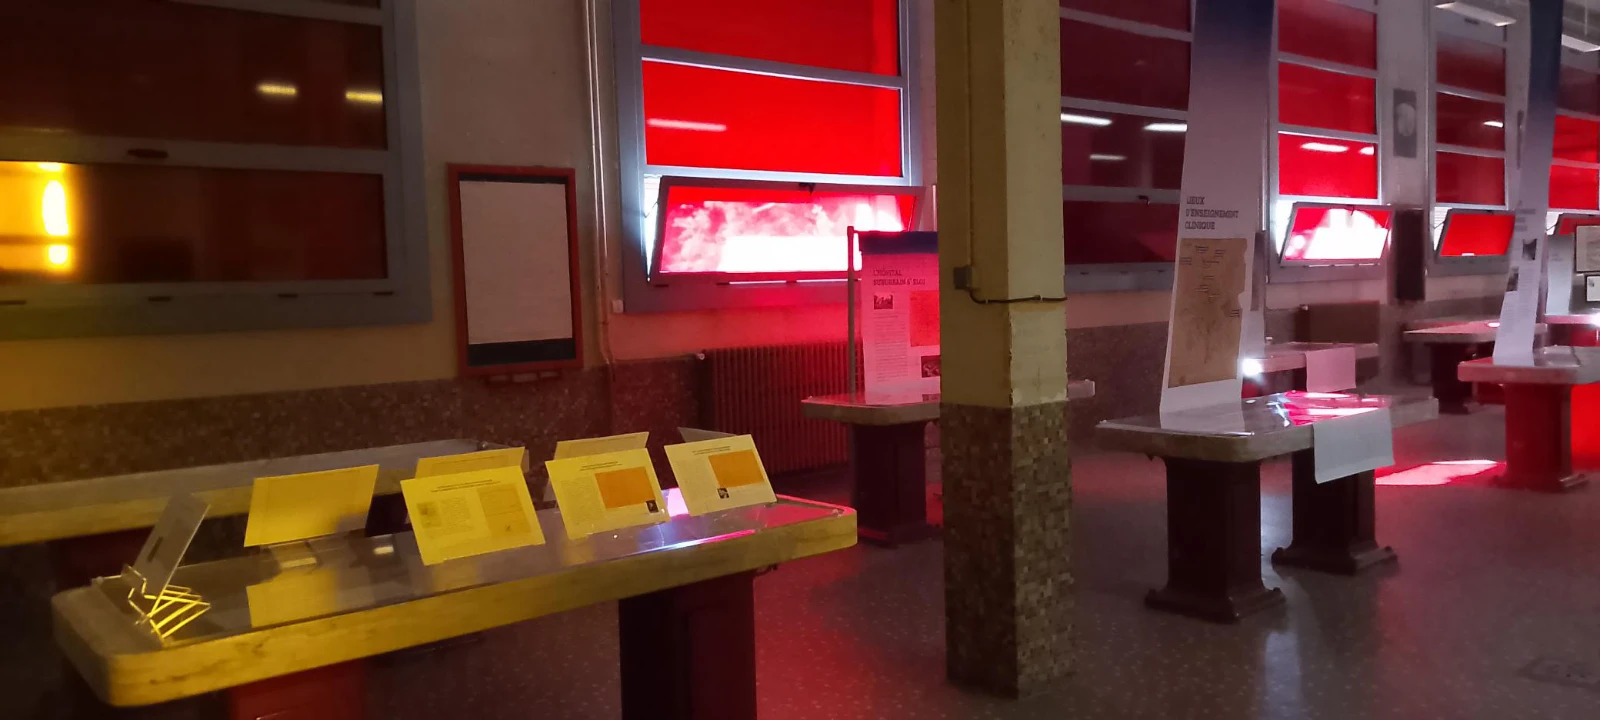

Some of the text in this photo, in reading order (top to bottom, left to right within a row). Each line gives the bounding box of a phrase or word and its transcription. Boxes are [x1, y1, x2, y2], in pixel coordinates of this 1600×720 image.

[1186, 196, 1205, 205] LIEUX
[1185, 208, 1239, 219] D'ENSEIGNEMENT
[1185, 221, 1215, 230] CLINIQUE
